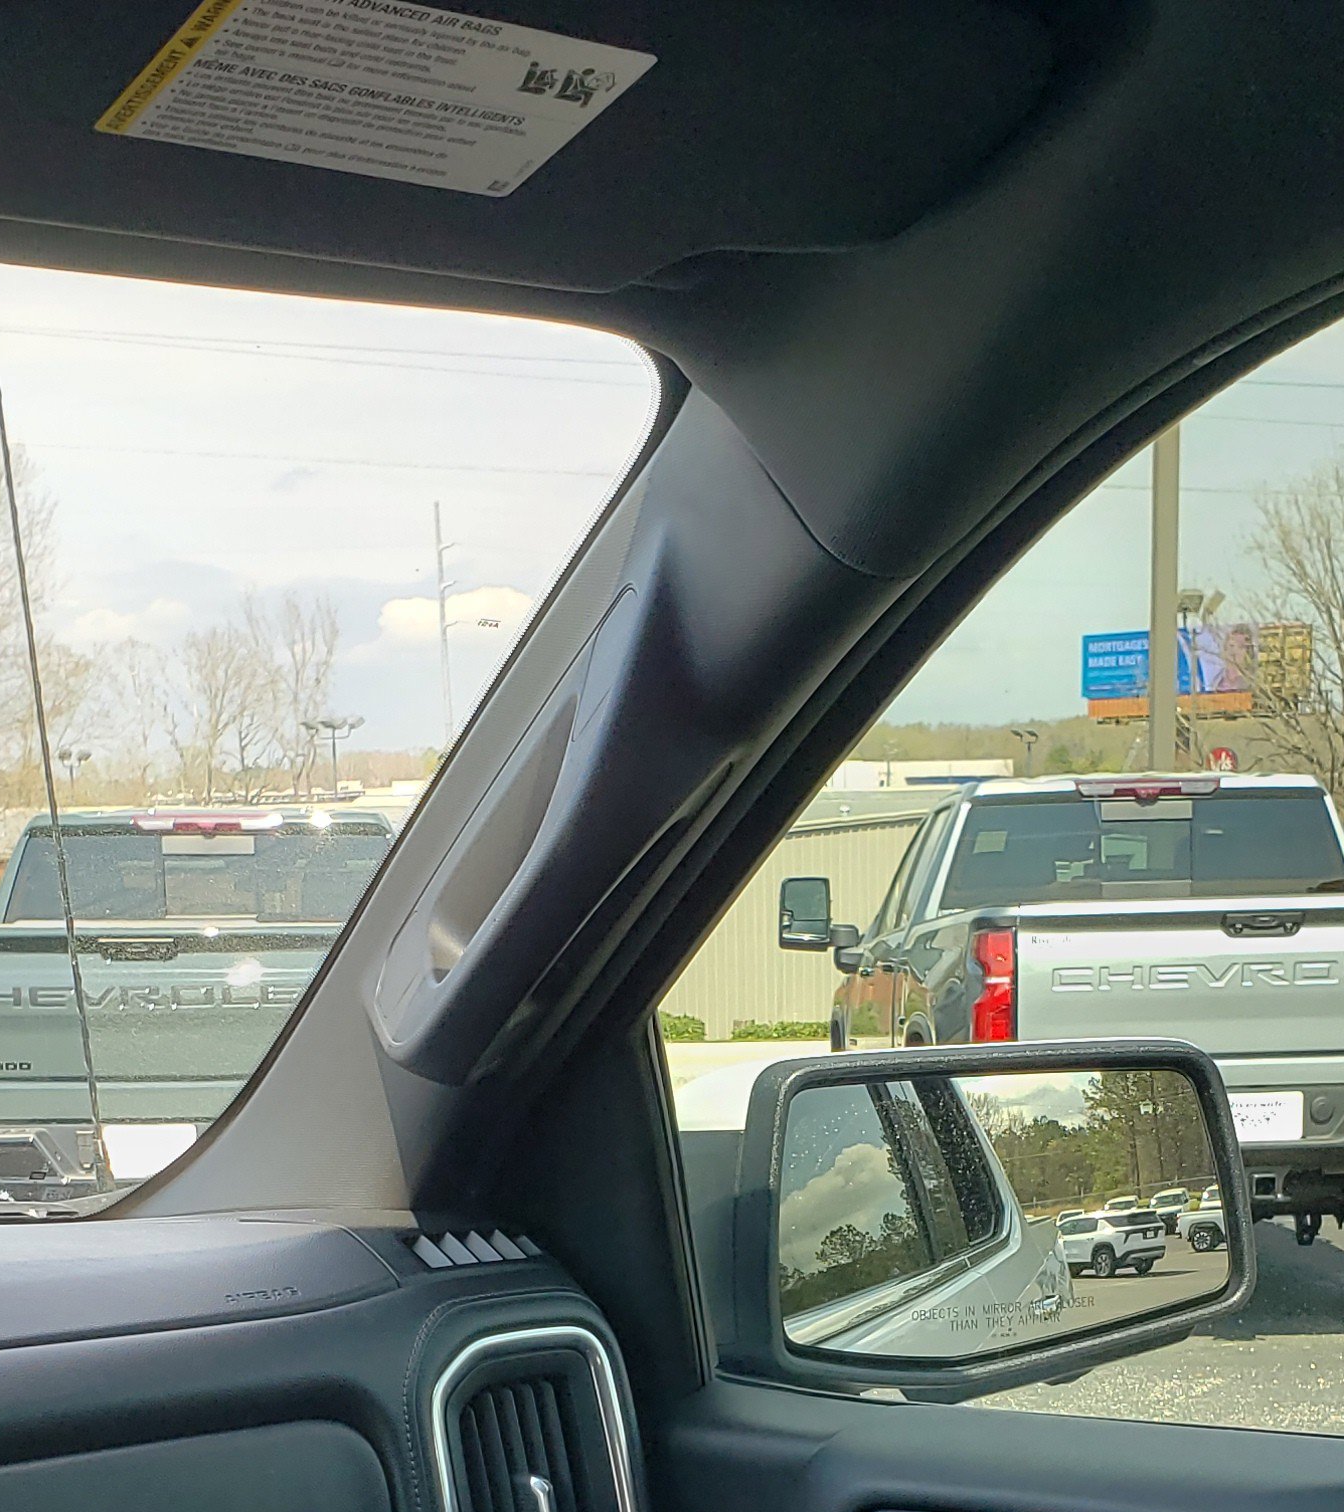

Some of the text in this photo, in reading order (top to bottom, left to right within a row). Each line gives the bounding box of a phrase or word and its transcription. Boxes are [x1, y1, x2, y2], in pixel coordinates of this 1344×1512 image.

[348, 0, 502, 35] ADVANCED AIR BAGS
[238, 66, 277, 80] AVEC
[278, 73, 308, 85] DES
[308, 79, 347, 93] SACS
[348, 87, 434, 108] GONFLABLES
[436, 102, 524, 125] INTELLIGENTS
[1088, 638, 1149, 653] MORTGAGES
[1088, 655, 1117, 668] MADE
[911, 1306, 959, 1321] OBJECTS
[964, 1305, 976, 1316] IN
[982, 1302, 1022, 1315] MIRROR
[1028, 1300, 1047, 1312] ARE
[950, 1313, 1061, 1332] THAN THEY APPEAR
